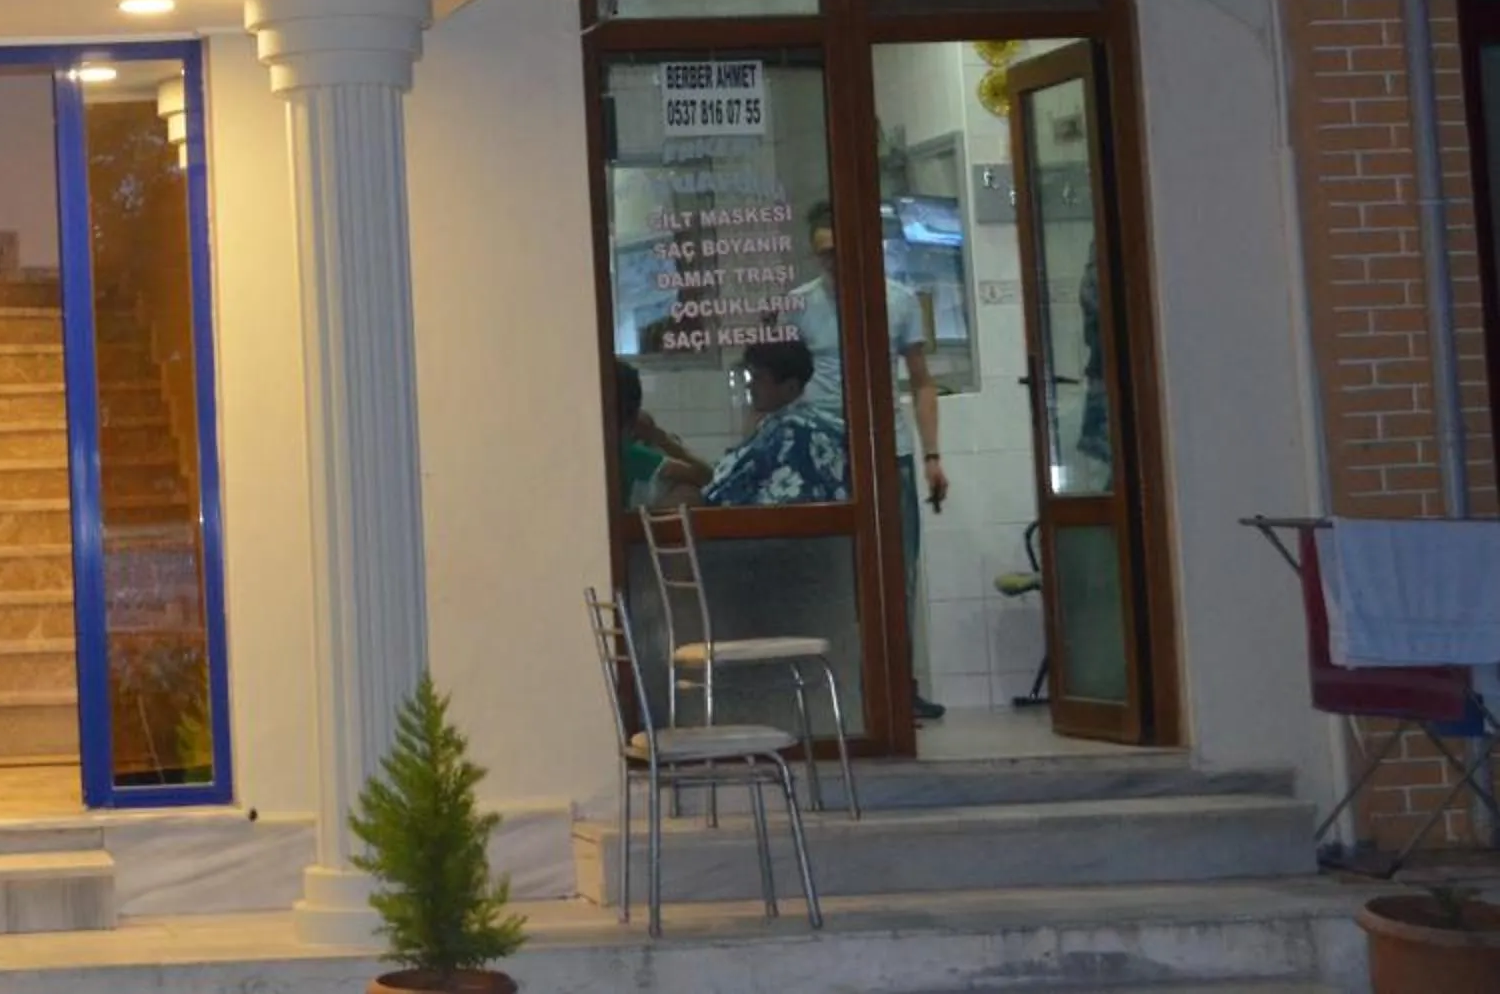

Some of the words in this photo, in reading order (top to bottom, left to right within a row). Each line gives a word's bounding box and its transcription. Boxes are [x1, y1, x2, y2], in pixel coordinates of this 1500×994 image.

[667, 65, 713, 89] BERBER
[716, 64, 757, 88] AHMET
[667, 99, 697, 126] 0537
[745, 98, 760, 124] 55
[657, 269, 726, 289] DAMAT
